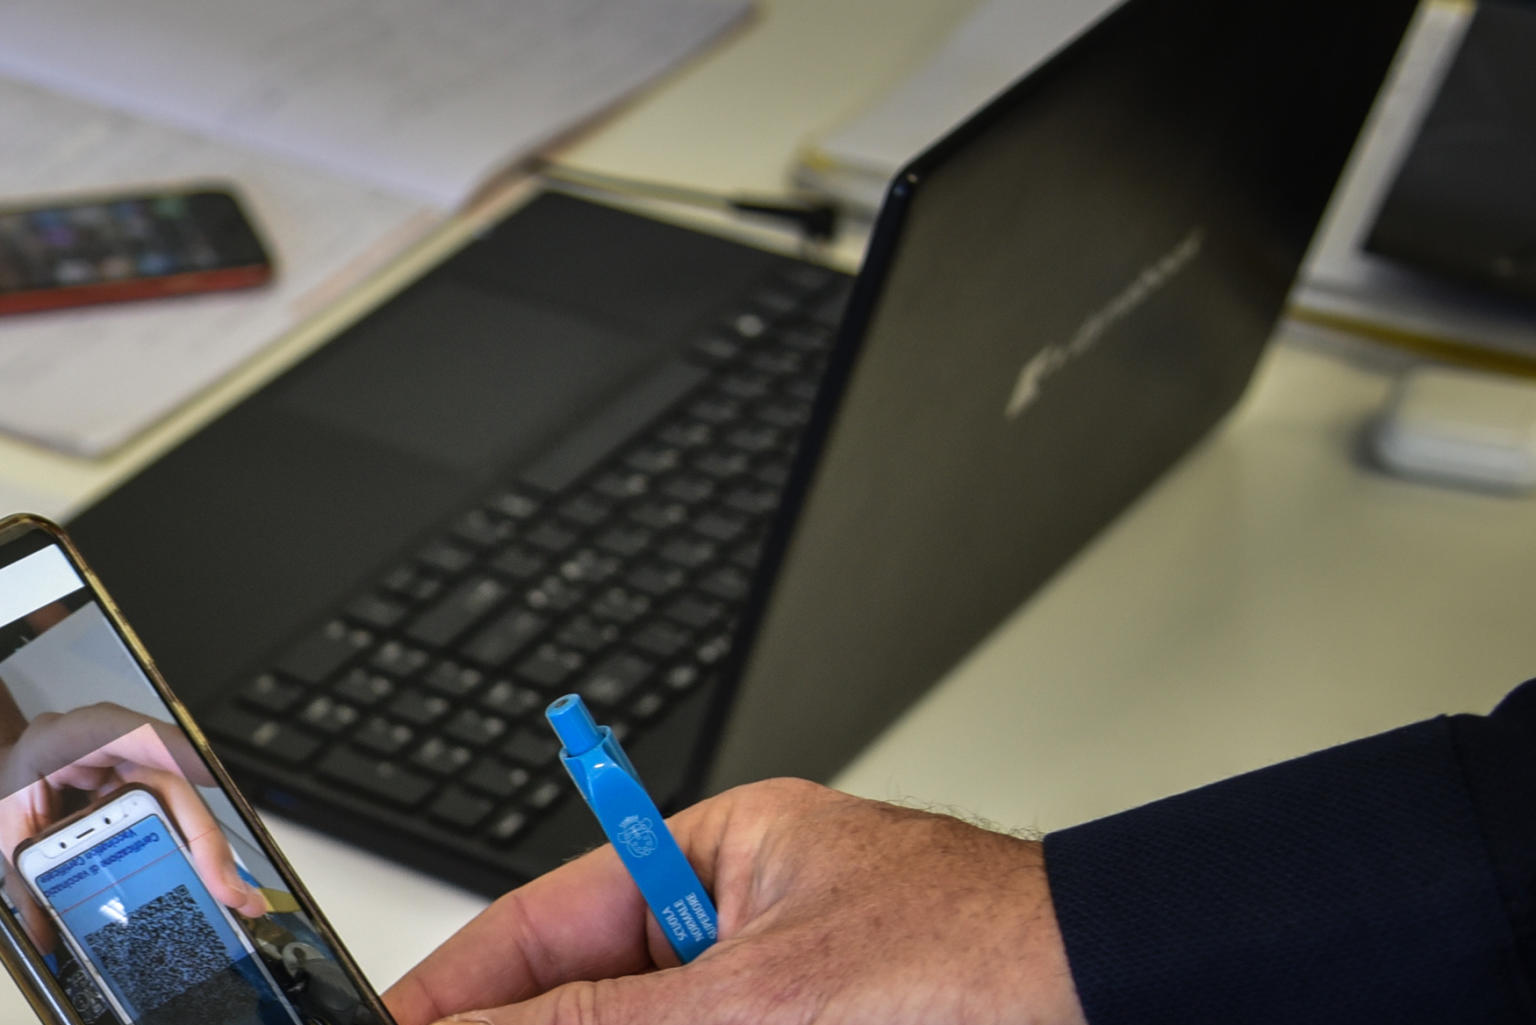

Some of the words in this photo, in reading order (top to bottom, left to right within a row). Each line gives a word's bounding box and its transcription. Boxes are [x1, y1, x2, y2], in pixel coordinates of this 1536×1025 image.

[101, 832, 159, 867] Certificazione
[88, 865, 99, 875] di
[661, 906, 688, 942] SCUOLA
[673, 899, 705, 942] NORMALE
